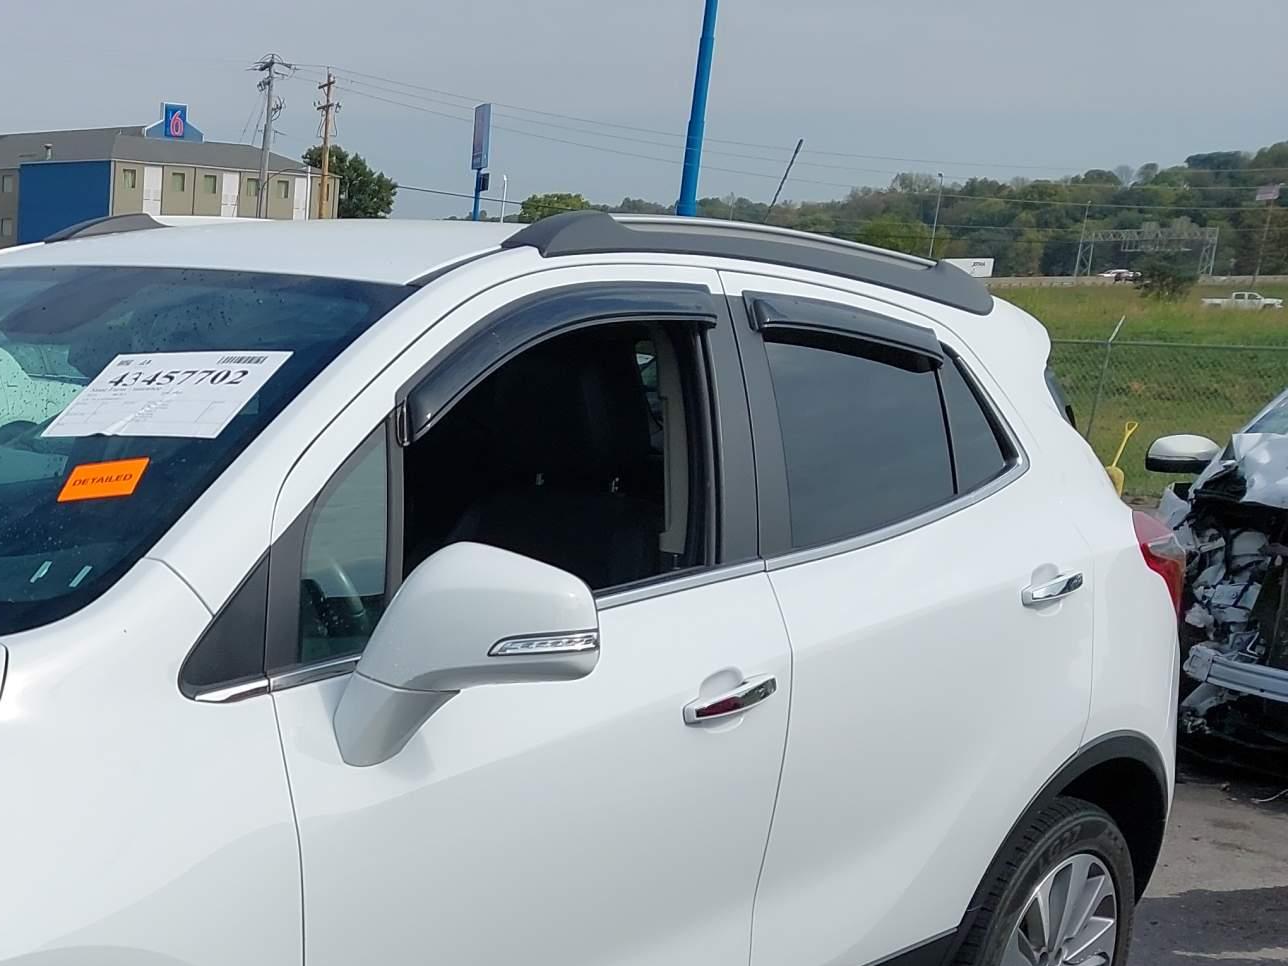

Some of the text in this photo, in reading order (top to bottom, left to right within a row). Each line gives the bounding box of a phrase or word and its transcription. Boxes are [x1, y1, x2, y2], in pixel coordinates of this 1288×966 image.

[170, 110, 184, 137] 6
[108, 369, 249, 387] 43457702
[72, 473, 133, 487] DETAILED
